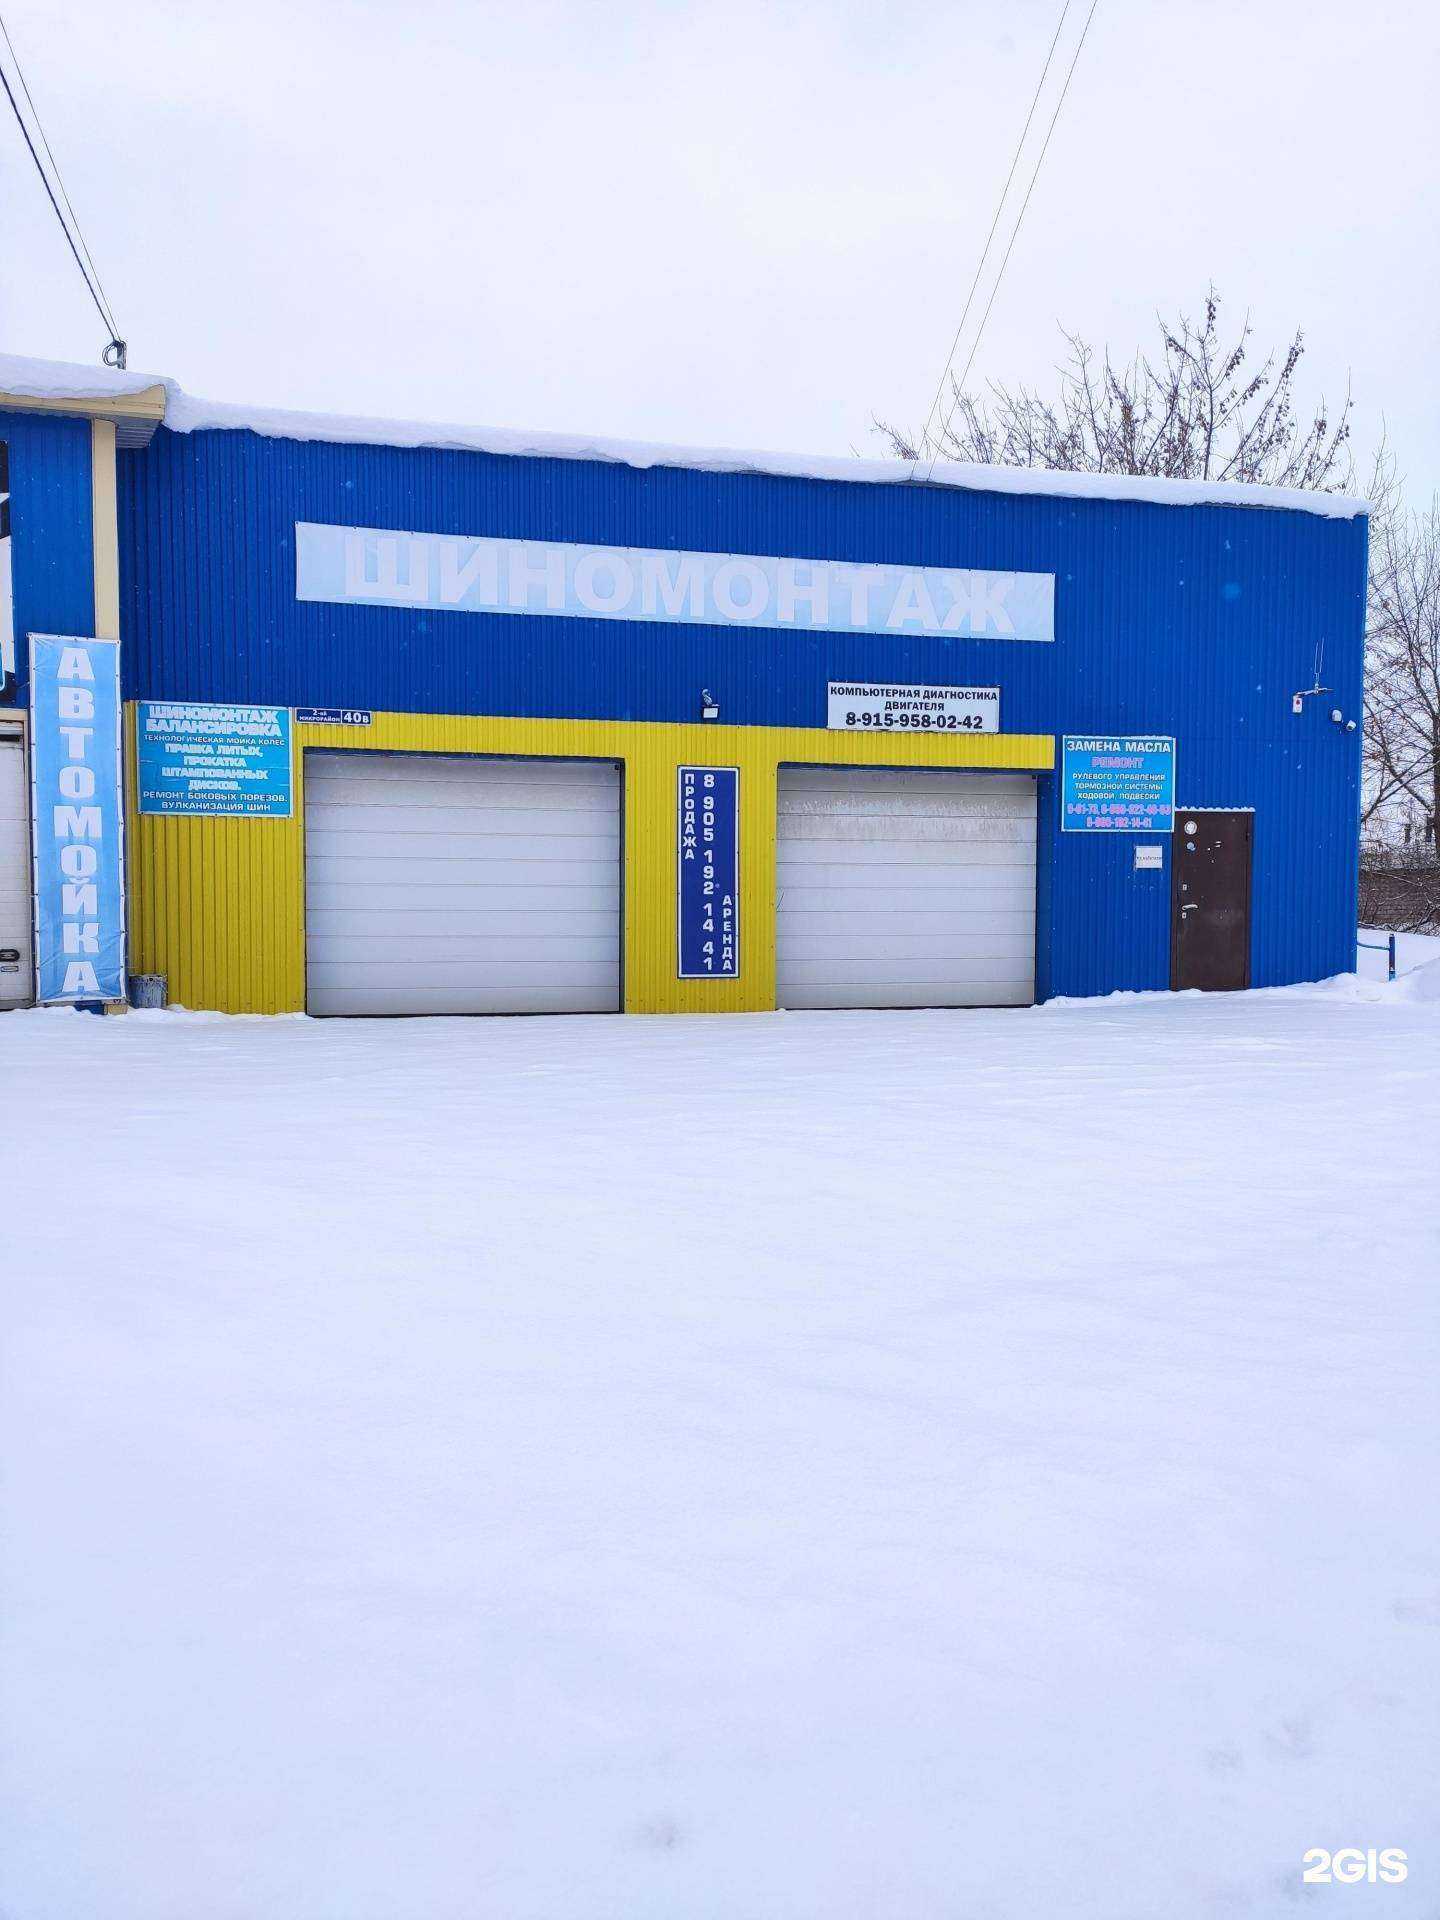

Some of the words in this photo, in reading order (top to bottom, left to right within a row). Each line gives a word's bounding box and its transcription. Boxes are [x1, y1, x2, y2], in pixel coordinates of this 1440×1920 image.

[343, 532, 1016, 633] ШИНОМОНТАЖ
[830, 686, 920, 699] КОМПЬЮТЕРНАЯ
[922, 690, 997, 701] ДИАГНОСТИКА
[884, 701, 945, 711] ДВИГАТЕЛЯ
[149, 706, 278, 723] ШИНОМОНТАЖ
[845, 711, 983, 729] 8-915-958-02-42
[146, 718, 282, 737] БАЛАНСИРОВКА
[144, 734, 224, 744] ТЕХНОЛОГИЧЕСКАЯ
[1066, 740, 1121, 752] ЗАМЕНА
[1125, 741, 1171, 753] МАСЛА
[183, 755, 247, 767] ПРОКАТКА
[1091, 757, 1144, 768] РЕМОНТ
[161, 766, 268, 780] ШТАМПОВАННЫХ
[1115, 773, 1166, 781] УПРАВЛЕНИЯ
[703, 774, 715, 788] 8
[1074, 782, 1123, 790] ТОРМОЗНОЙ
[143, 790, 184, 799] РЕМОНТ
[187, 791, 237, 801] БОКОВЫХ
[240, 793, 288, 802] ПОРЕЗОВ.
[1119, 792, 1161, 800] ПОДВЕСКИ
[161, 801, 243, 811] ВУЛКАНИЗАЦИЯ
[246, 803, 271, 811] ШИН
[53, 646, 102, 993] АВТОМОЙКА
[682, 774, 697, 860] ПРОДАЖА
[703, 796, 715, 842] 905
[703, 849, 714, 895] 192
[702, 903, 714, 932] 14
[722, 895, 732, 970] АРЕНДА
[702, 941, 714, 970] 41
